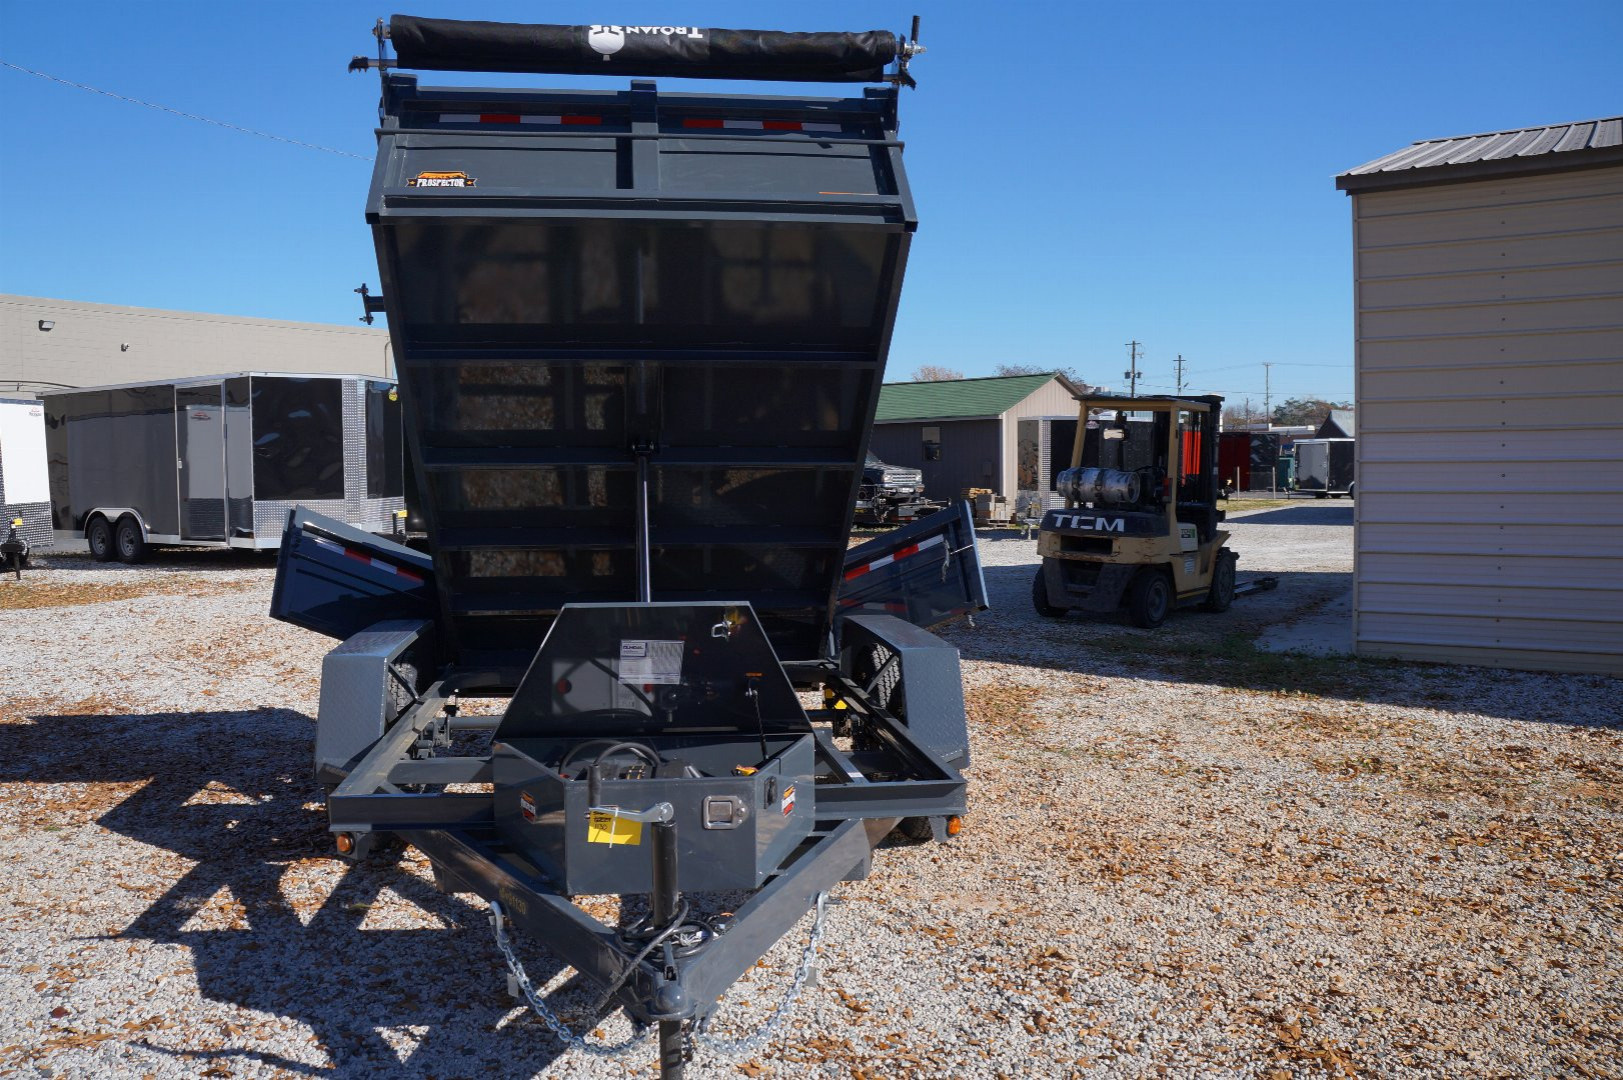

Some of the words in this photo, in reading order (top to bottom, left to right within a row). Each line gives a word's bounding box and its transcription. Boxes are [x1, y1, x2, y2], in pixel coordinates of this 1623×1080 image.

[625, 26, 704, 39] TROJAN
[416, 178, 465, 188] PROSPECTOR
[1052, 513, 1125, 532] TCM
